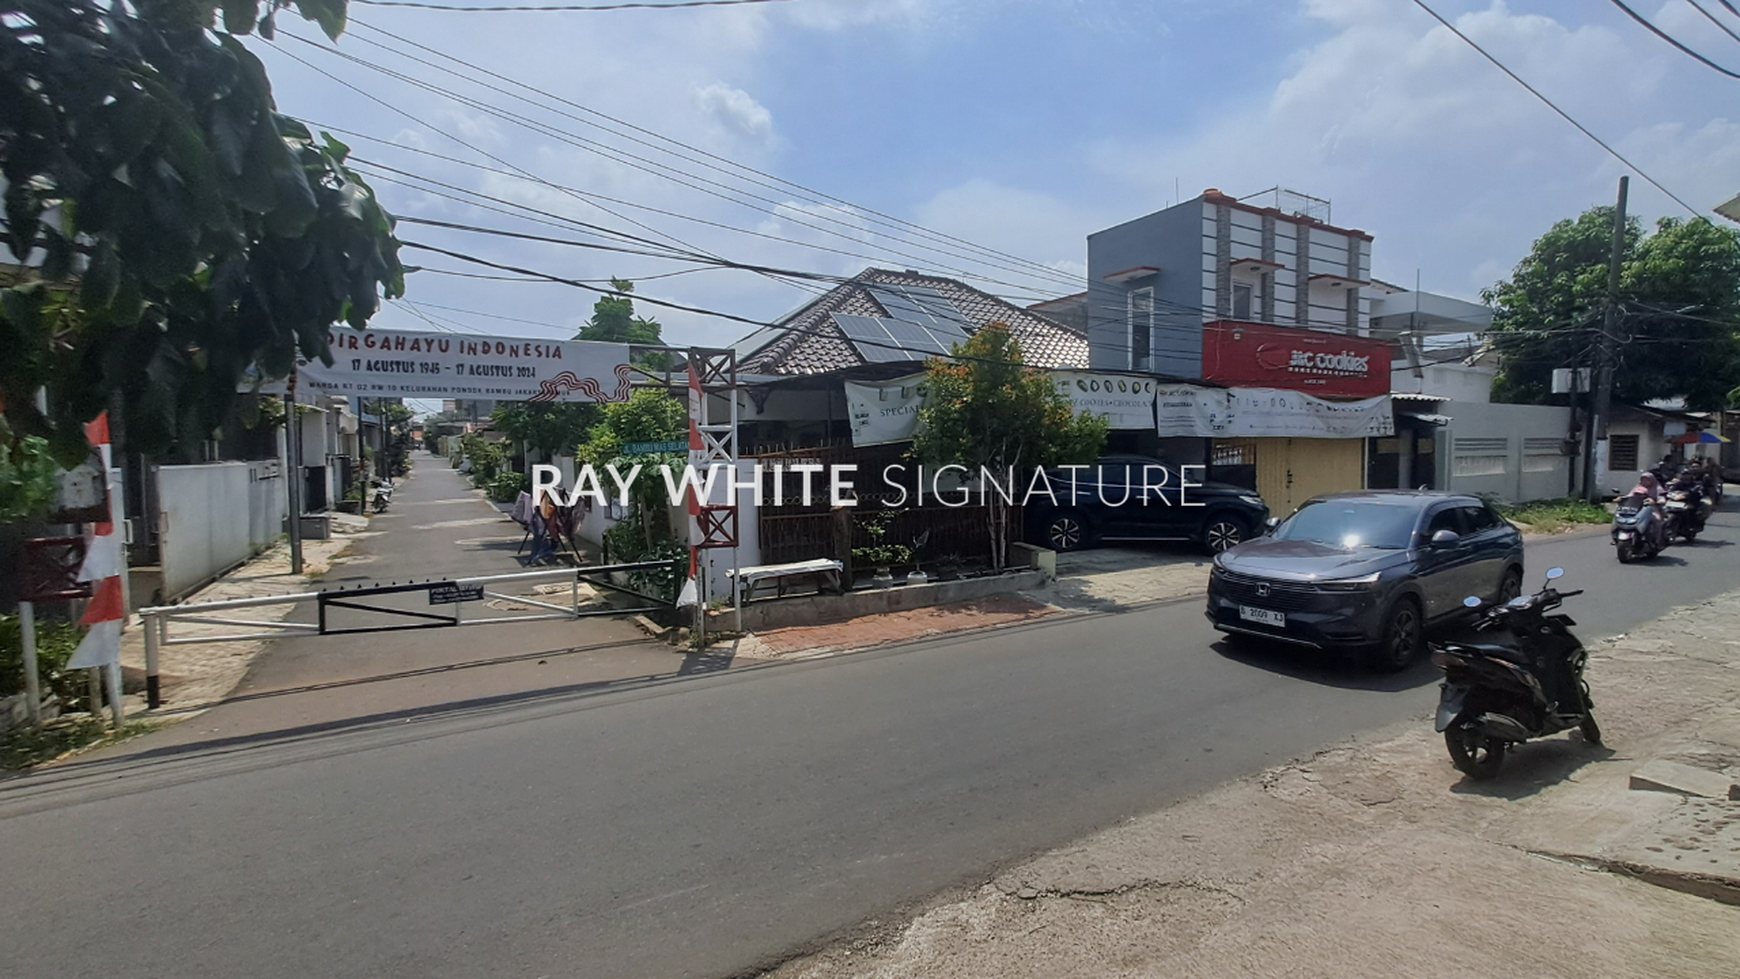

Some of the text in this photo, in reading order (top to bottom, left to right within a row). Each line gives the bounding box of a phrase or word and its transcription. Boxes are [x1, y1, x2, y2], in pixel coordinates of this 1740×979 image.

[459, 340, 562, 359] INDONESIA
[351, 359, 361, 371] 17
[366, 360, 415, 373] AGUSTUS
[419, 362, 440, 374] 1945
[455, 363, 465, 375] 17
[468, 364, 513, 377] AGUSTUS
[516, 366, 536, 378] 2024
[308, 381, 339, 389] WARGA
[400, 385, 448, 393] KELURAHAN
[451, 386, 482, 394] PONDOK
[485, 387, 511, 395] BAMBU
[514, 388, 541, 396] JAKART
